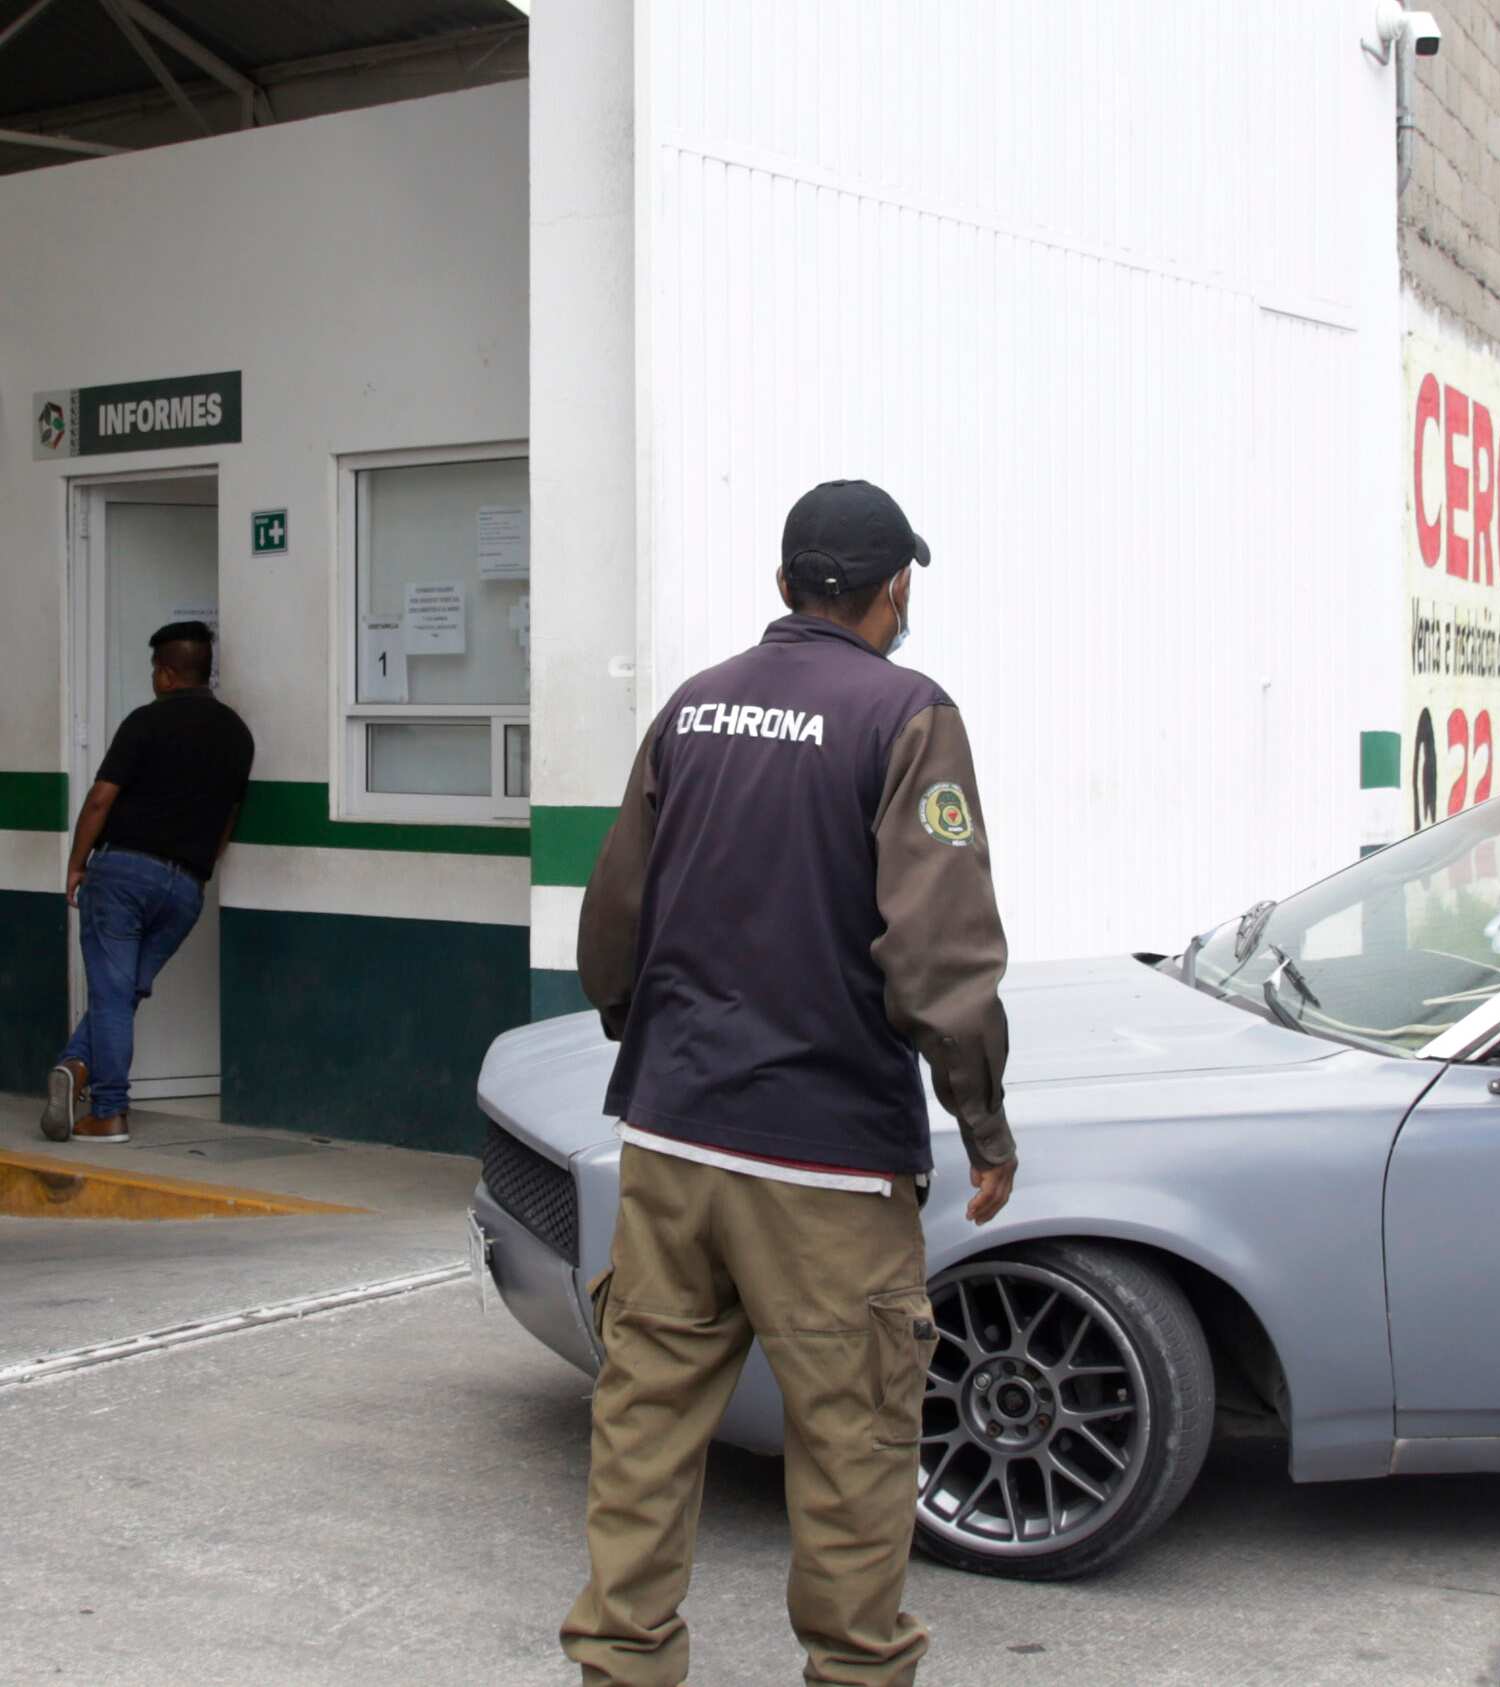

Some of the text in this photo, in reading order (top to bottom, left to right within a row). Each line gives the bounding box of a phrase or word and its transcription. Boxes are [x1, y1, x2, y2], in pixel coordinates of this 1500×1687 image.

[99, 393, 222, 436] INFORMES
[1412, 597, 1440, 676] Venta
[378, 652, 387, 677] 1
[677, 703, 824, 746] OCHRONA
